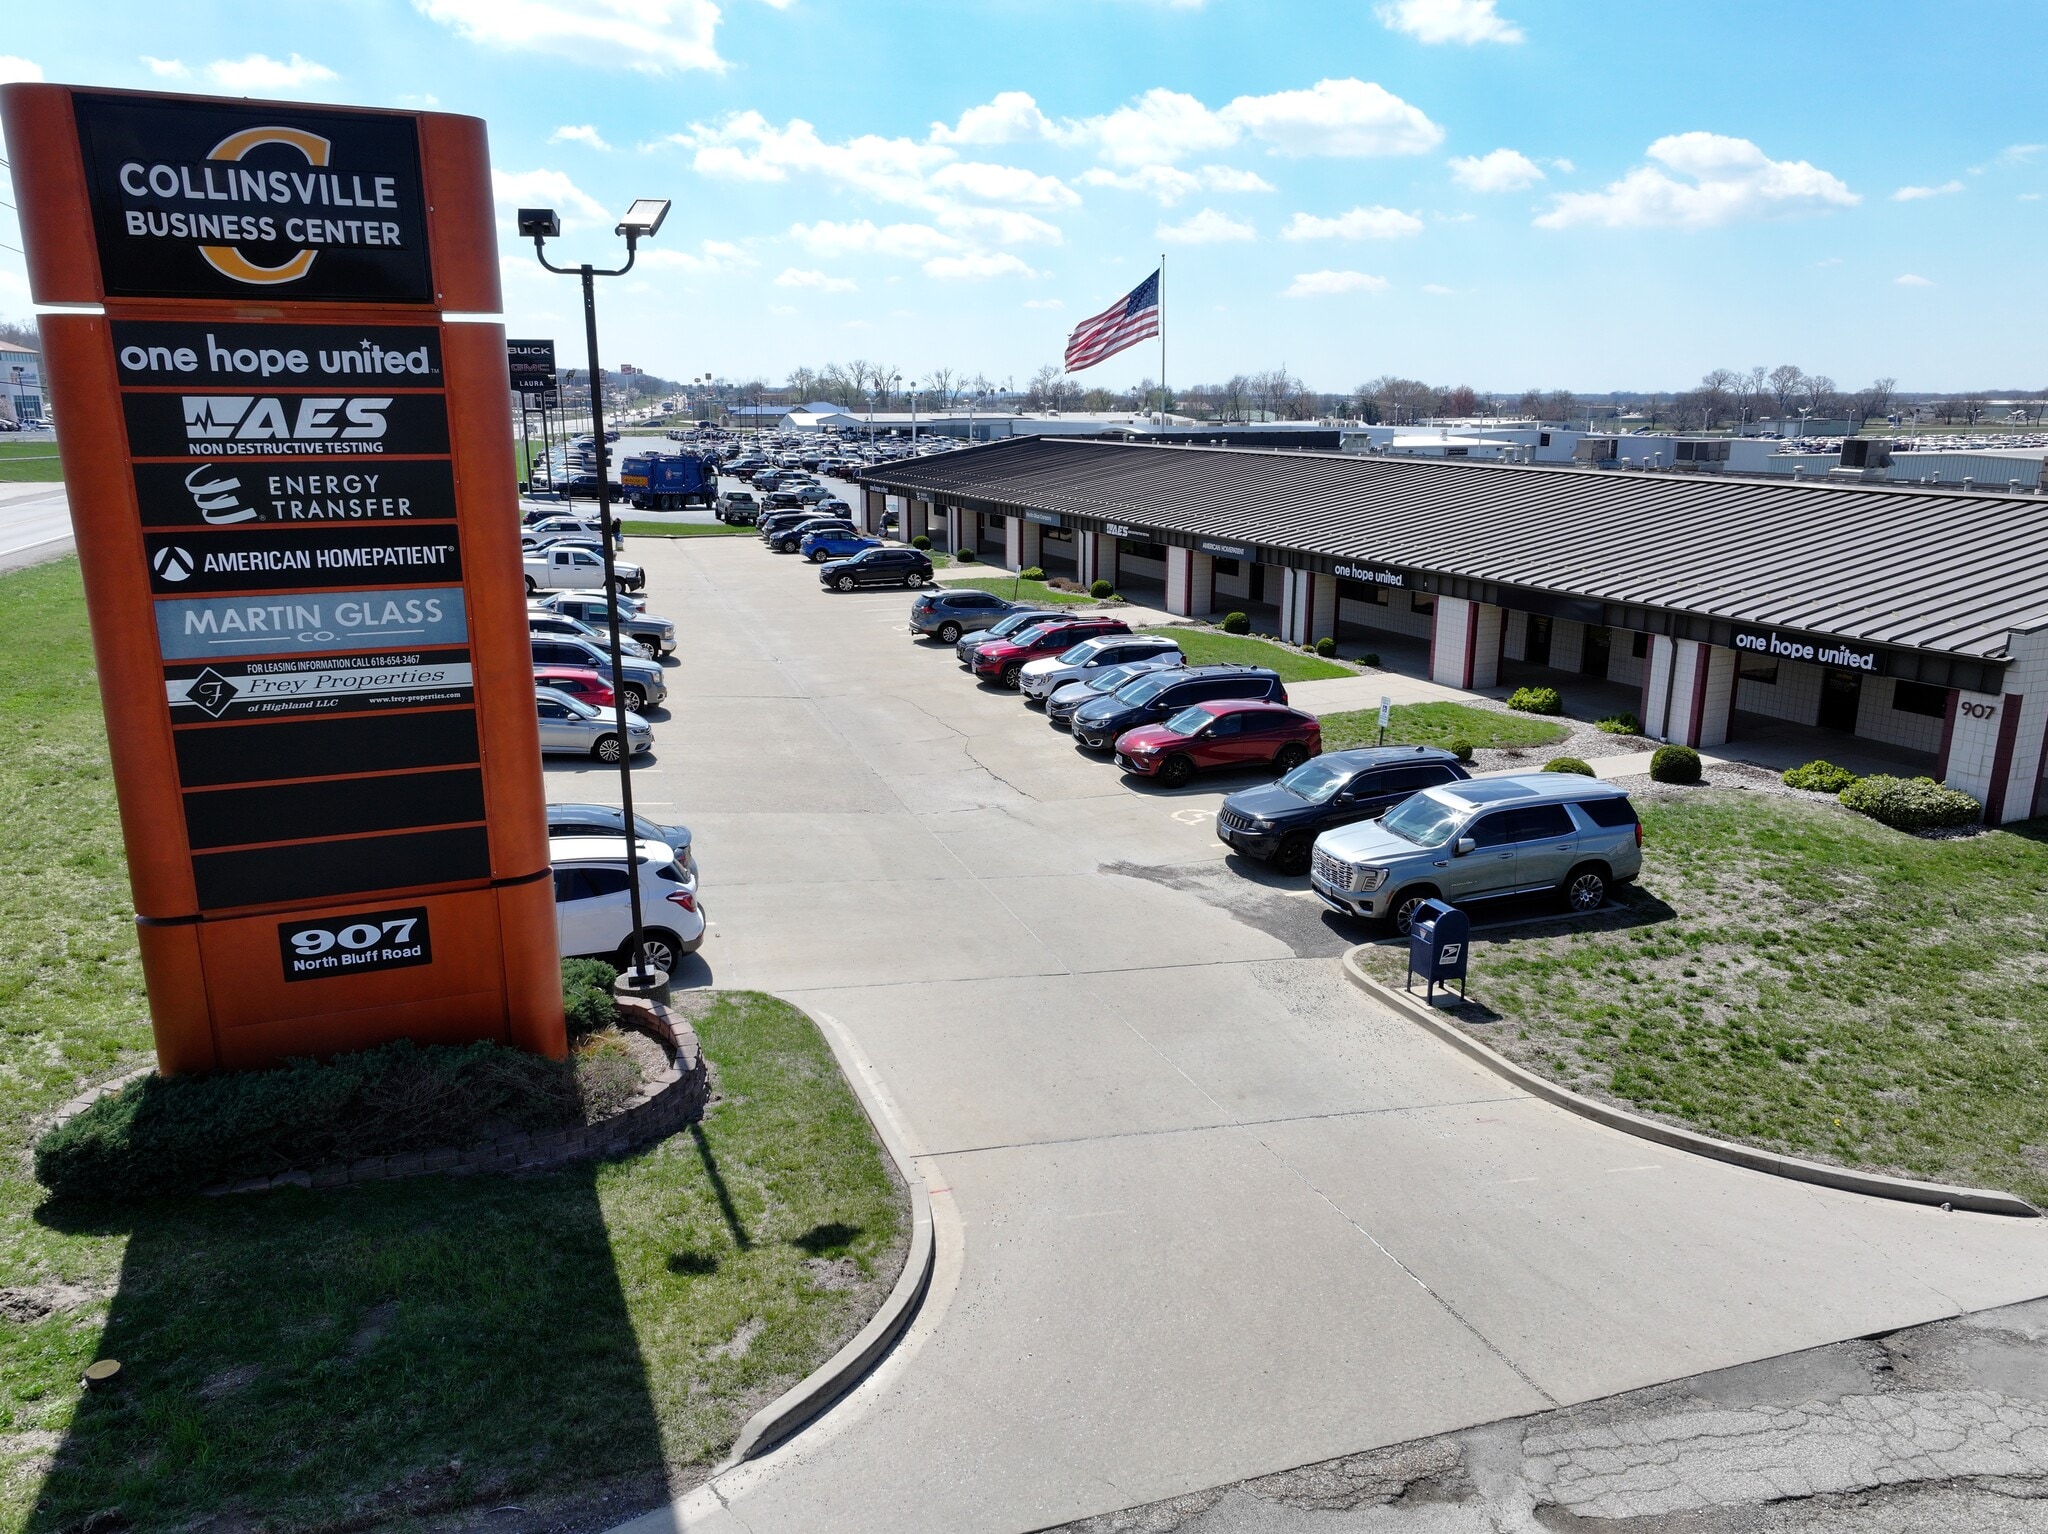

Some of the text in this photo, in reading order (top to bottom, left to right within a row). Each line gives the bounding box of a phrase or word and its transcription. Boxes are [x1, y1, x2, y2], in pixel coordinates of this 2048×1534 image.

[119, 162, 398, 208] COLLINSVILLE
[125, 210, 402, 246] BUSINESS CENTER
[120, 333, 429, 377] one hope united
[511, 363, 550, 371] GMC
[236, 397, 394, 439] AES
[189, 442, 384, 455] NON DESTRUCTIVE TESTING
[269, 475, 380, 495] ENERGY
[272, 498, 413, 519] TRANSFER
[203, 550, 311, 573] AMERICAN
[1334, 563, 1403, 586] one hope united
[184, 598, 443, 635] MARTIN GLASS
[297, 630, 342, 643] CO.
[1736, 633, 1874, 671] one hope united
[247, 654, 421, 674] FOR LEASING INFORMATION CALL 618-654-3467
[247, 668, 446, 695] Frey Properties
[247, 698, 339, 713] of Highland LLC
[369, 691, 462, 704] www.frey-properties.com
[1960, 701, 1995, 720] 907
[290, 917, 418, 955] 907
[293, 944, 422, 971] North Bluff Road
